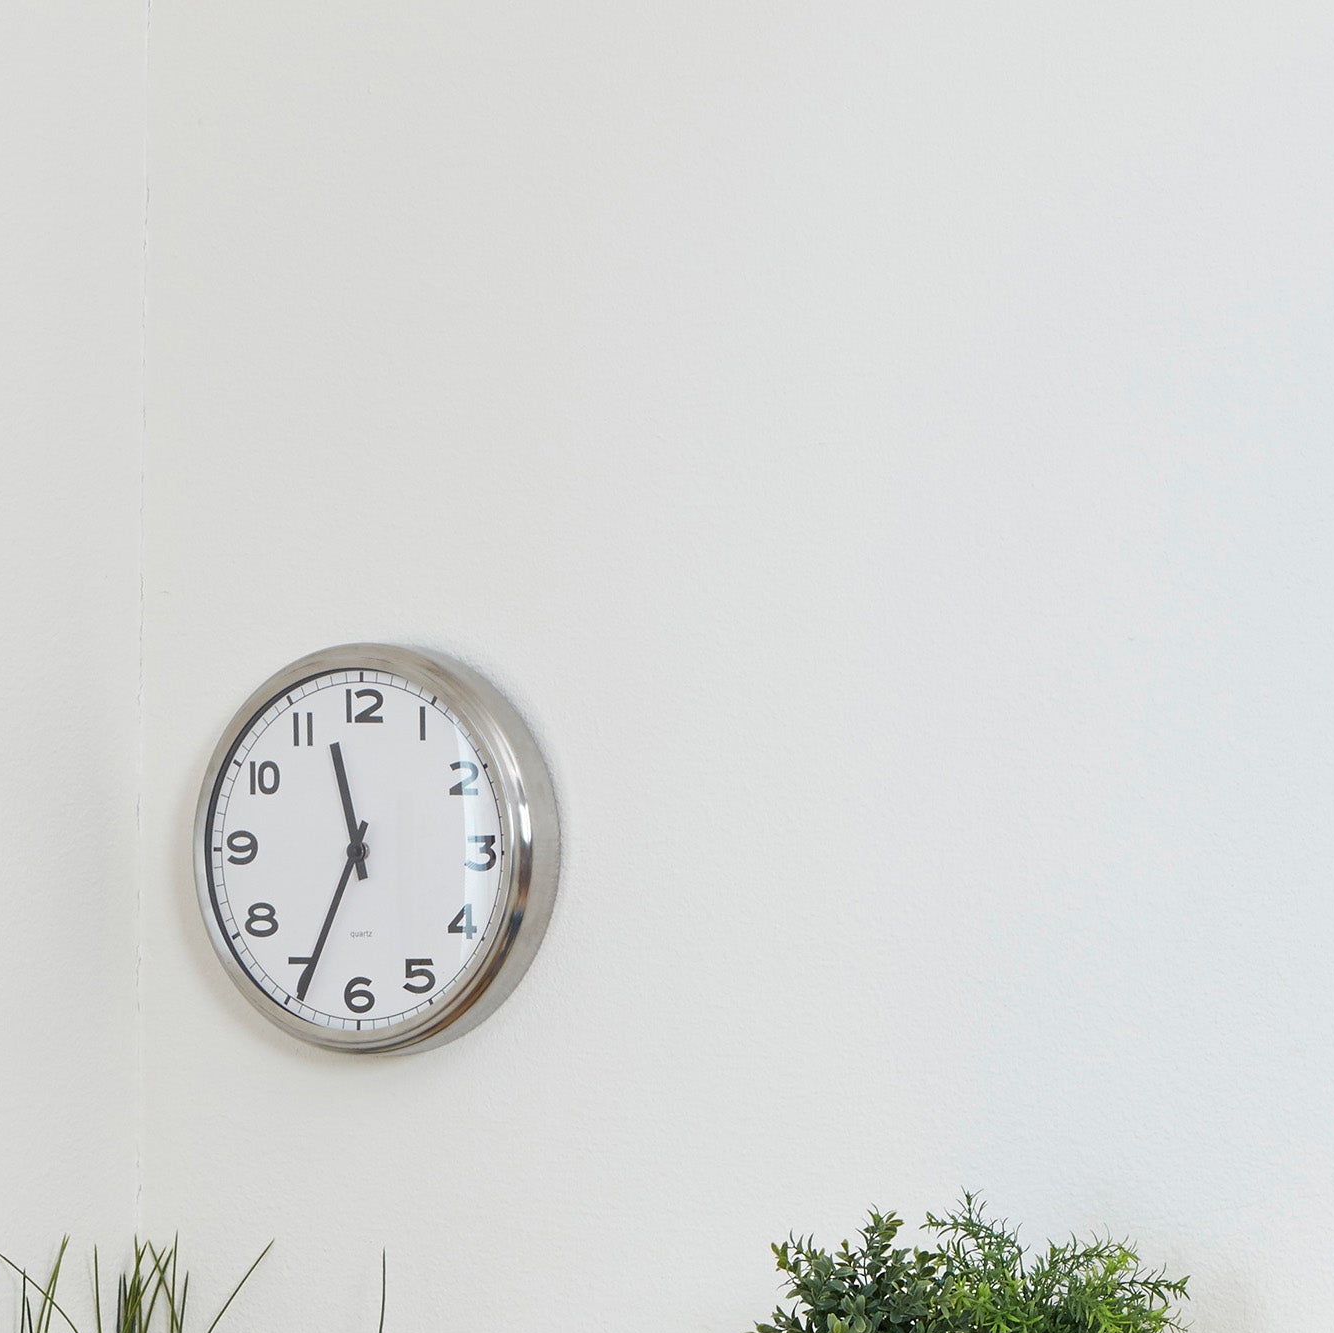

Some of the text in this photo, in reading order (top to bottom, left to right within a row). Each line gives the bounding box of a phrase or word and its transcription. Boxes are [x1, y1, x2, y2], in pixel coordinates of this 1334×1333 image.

[346, 689, 384, 723] 12
[419, 706, 426, 741] 1
[293, 712, 313, 746] 11
[249, 761, 280, 795] 10
[449, 761, 479, 795] 2
[227, 830, 258, 865] 9
[464, 835, 496, 871] 3
[244, 902, 279, 937] 8
[448, 904, 478, 940] 4
[288, 957, 316, 994] 7
[403, 958, 436, 994] 5
[344, 977, 375, 1013] 6
